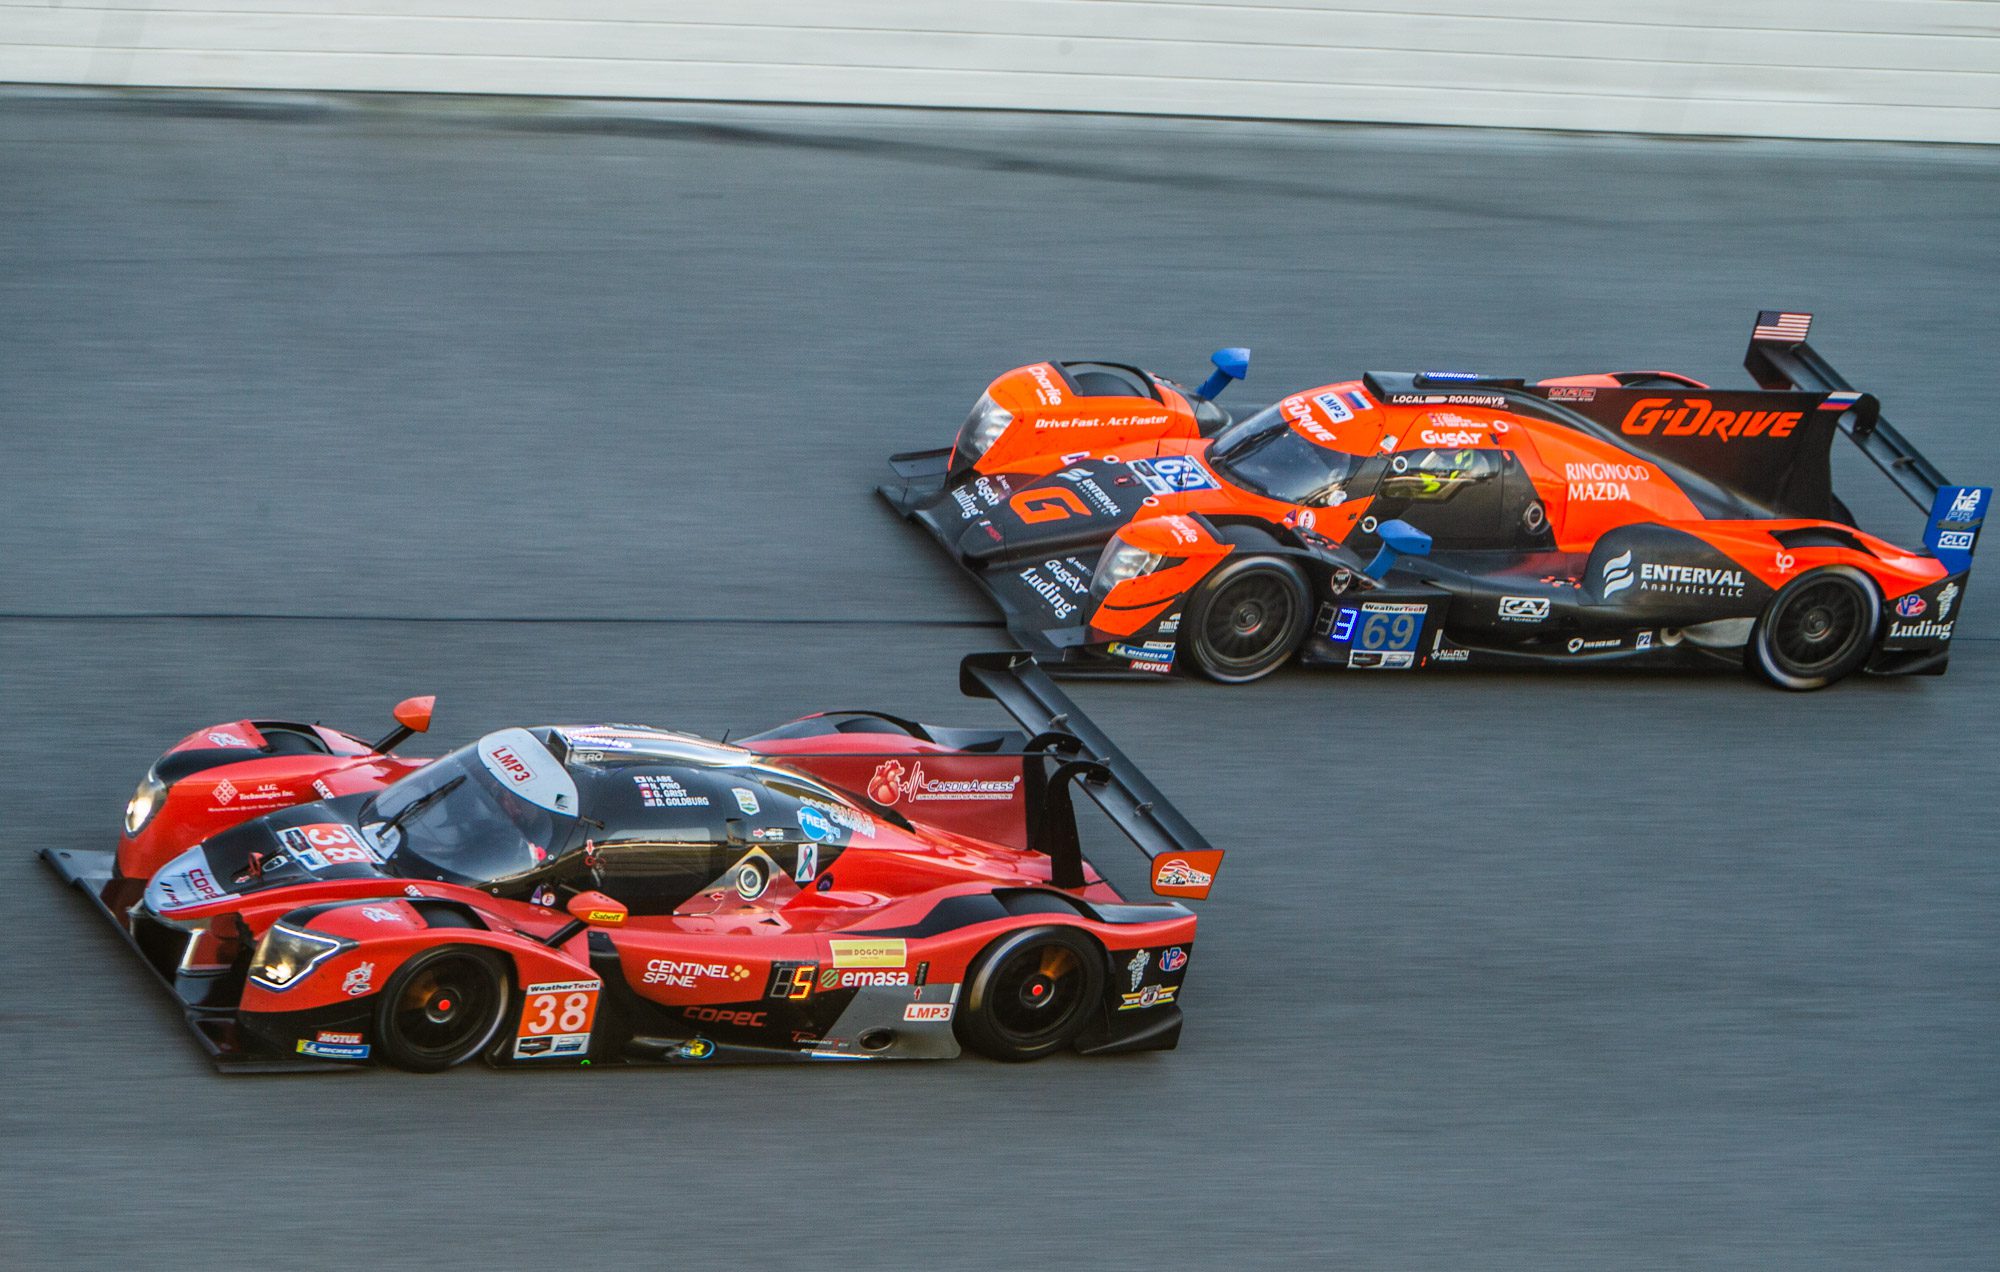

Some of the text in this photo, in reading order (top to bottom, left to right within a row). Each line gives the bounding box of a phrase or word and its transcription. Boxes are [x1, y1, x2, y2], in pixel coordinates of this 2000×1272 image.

[1320, 394, 1347, 419] LMP2
[1392, 395, 1505, 406] LOCAL ROADWAYS
[1035, 419, 1069, 428] Drive
[1071, 418, 1099, 427] Fast
[1107, 416, 1129, 426] Act
[1130, 416, 1168, 426] Faster
[1154, 459, 1206, 488] 69
[1565, 463, 1650, 481] RINGWOOD
[1082, 478, 1122, 517] ENTERVAL
[1568, 482, 1631, 501] MAZDA
[1009, 486, 1093, 524] G
[1944, 535, 1968, 546] CLC
[1641, 563, 1746, 587] ENTERVAL
[1019, 567, 1078, 620] Luding
[1640, 581, 1744, 598] Analytics LLC
[1331, 608, 1359, 641] 3
[1361, 614, 1416, 650] 69
[1889, 621, 1954, 640] Luding
[1127, 649, 1169, 659] MICHELIN
[1132, 661, 1170, 673] MOTUL
[491, 747, 531, 782] LMP3
[660, 782, 681, 790] PINO
[663, 789, 687, 798] GRIST
[239, 791, 281, 801] Technologies
[656, 797, 710, 807] D. GOLDBURG
[308, 829, 366, 861] 38
[647, 959, 730, 979] CENTINEL
[530, 982, 598, 992] WeatherTech
[789, 966, 815, 999] 5
[841, 971, 910, 987] emasa
[528, 992, 589, 1034] 38
[906, 1007, 950, 1019] LMP3
[318, 1033, 361, 1044] MOTUL
